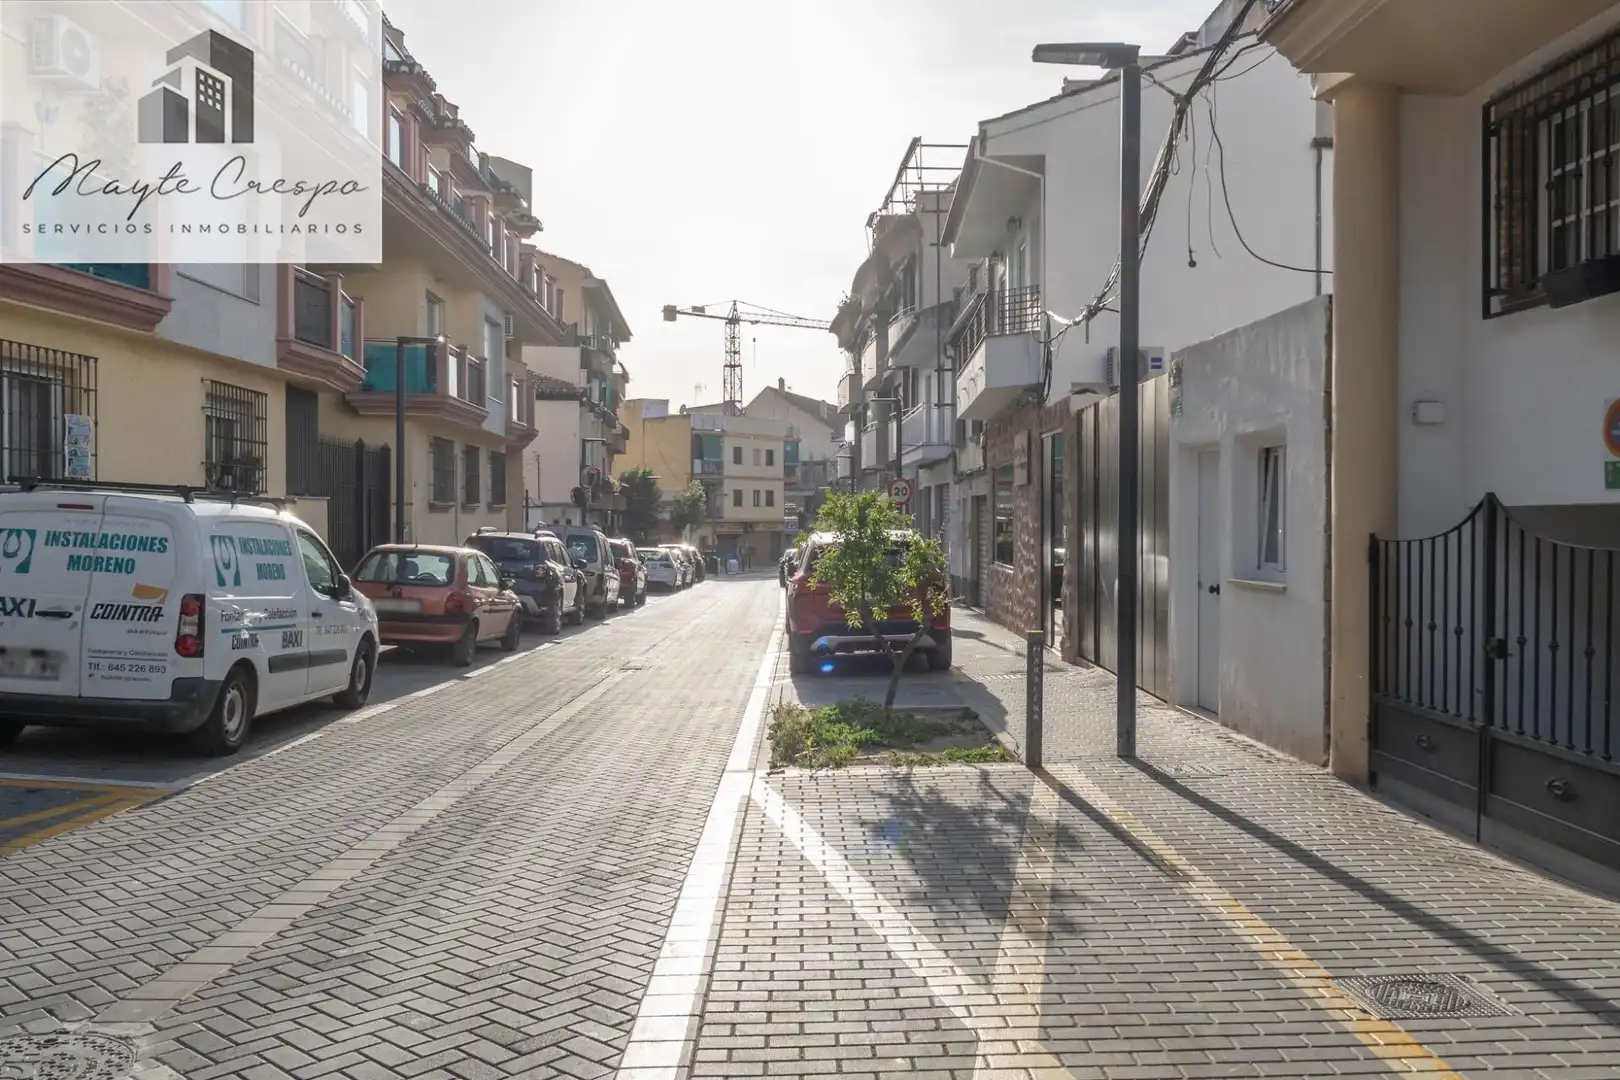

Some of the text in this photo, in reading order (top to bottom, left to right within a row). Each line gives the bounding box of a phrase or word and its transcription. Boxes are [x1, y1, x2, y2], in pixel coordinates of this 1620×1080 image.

[894, 486, 908, 496] 20
[44, 529, 168, 554] INSTALACIONES
[238, 536, 292, 557] INSTALACIONES
[66, 554, 136, 575] MORENO
[256, 563, 286, 581] MORENO
[90, 602, 165, 623] COINTRA
[282, 629, 304, 649] BAXI
[107, 663, 126, 672] 645
[128, 664, 146, 673] 226
[148, 665, 167, 674] 893
